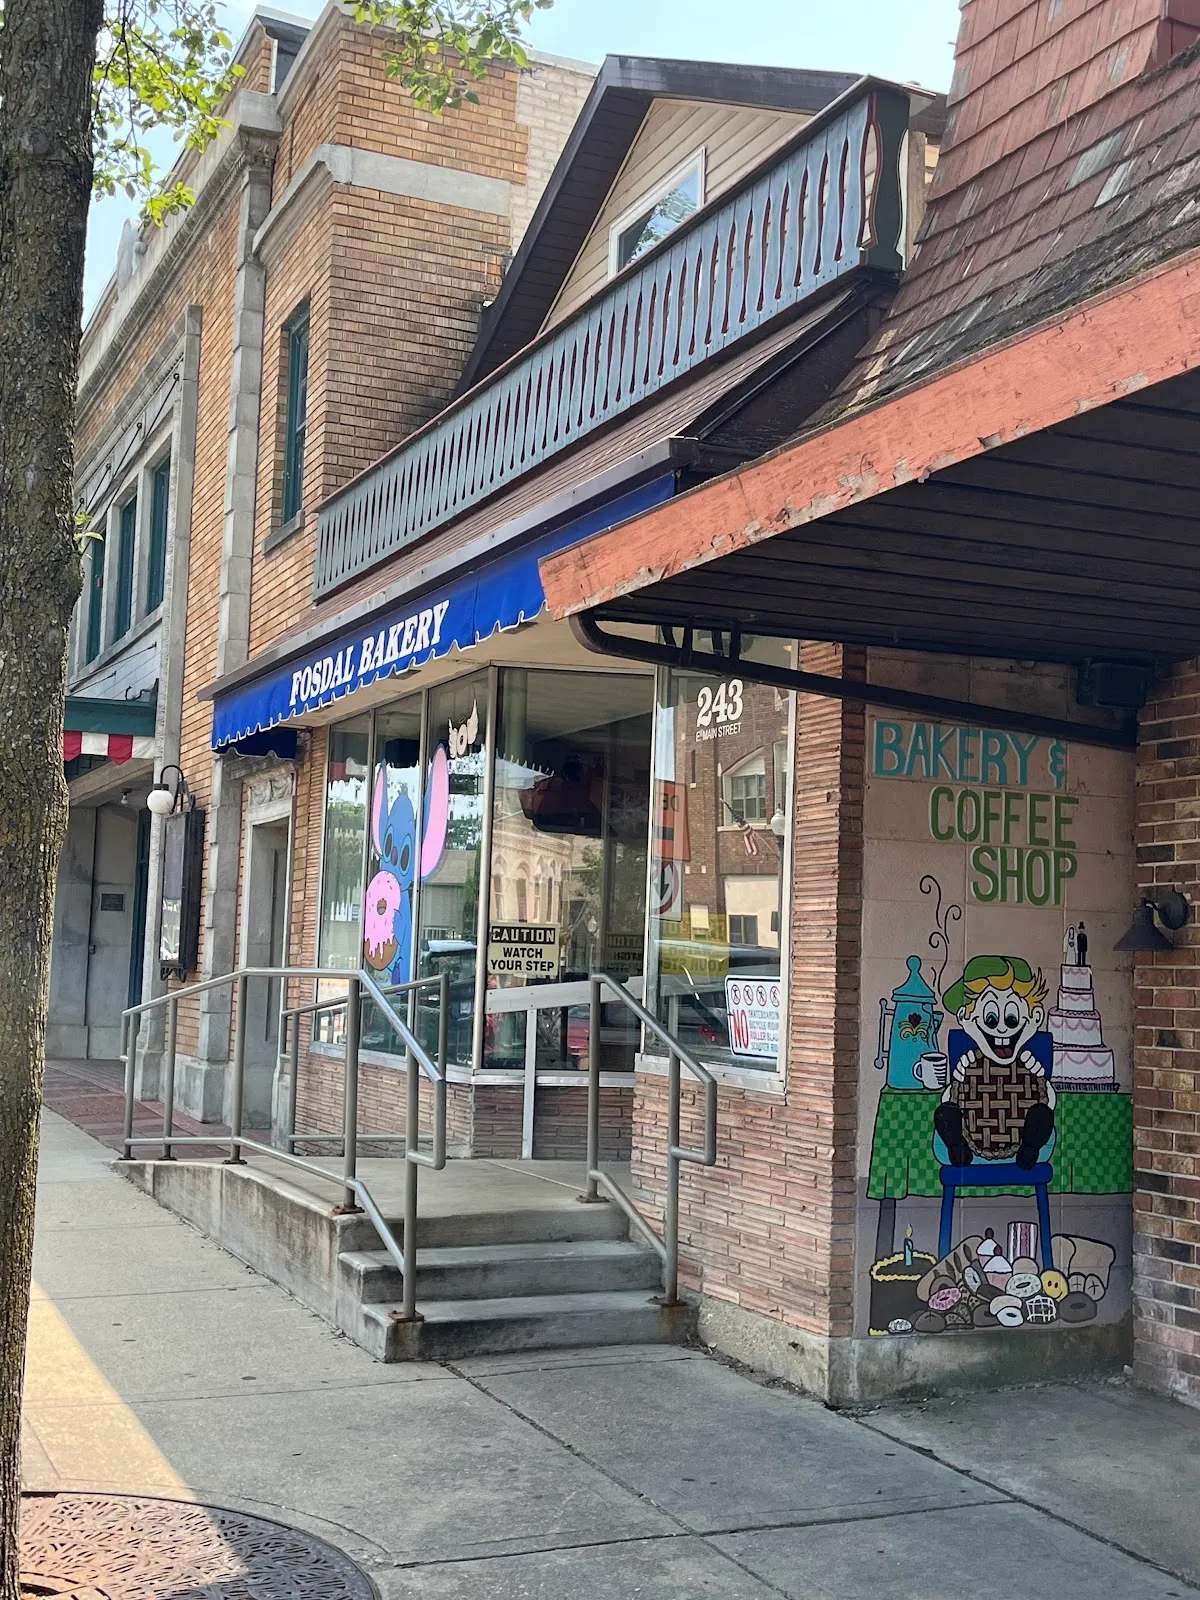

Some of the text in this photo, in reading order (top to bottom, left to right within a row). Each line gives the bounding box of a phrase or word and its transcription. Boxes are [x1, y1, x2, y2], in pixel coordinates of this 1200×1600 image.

[289, 600, 450, 706] FOSDAL BAKERY
[697, 679, 743, 727] 243
[718, 722, 742, 738] STREET
[873, 719, 1066, 789] BAKERY &
[929, 786, 1079, 849] COFFEE
[970, 845, 1078, 905] SHOP
[492, 928, 554, 943] CAUTION
[503, 947, 543, 959] WATCH
[490, 959, 555, 972] YOUR STEP
[732, 1009, 749, 1049] NO
